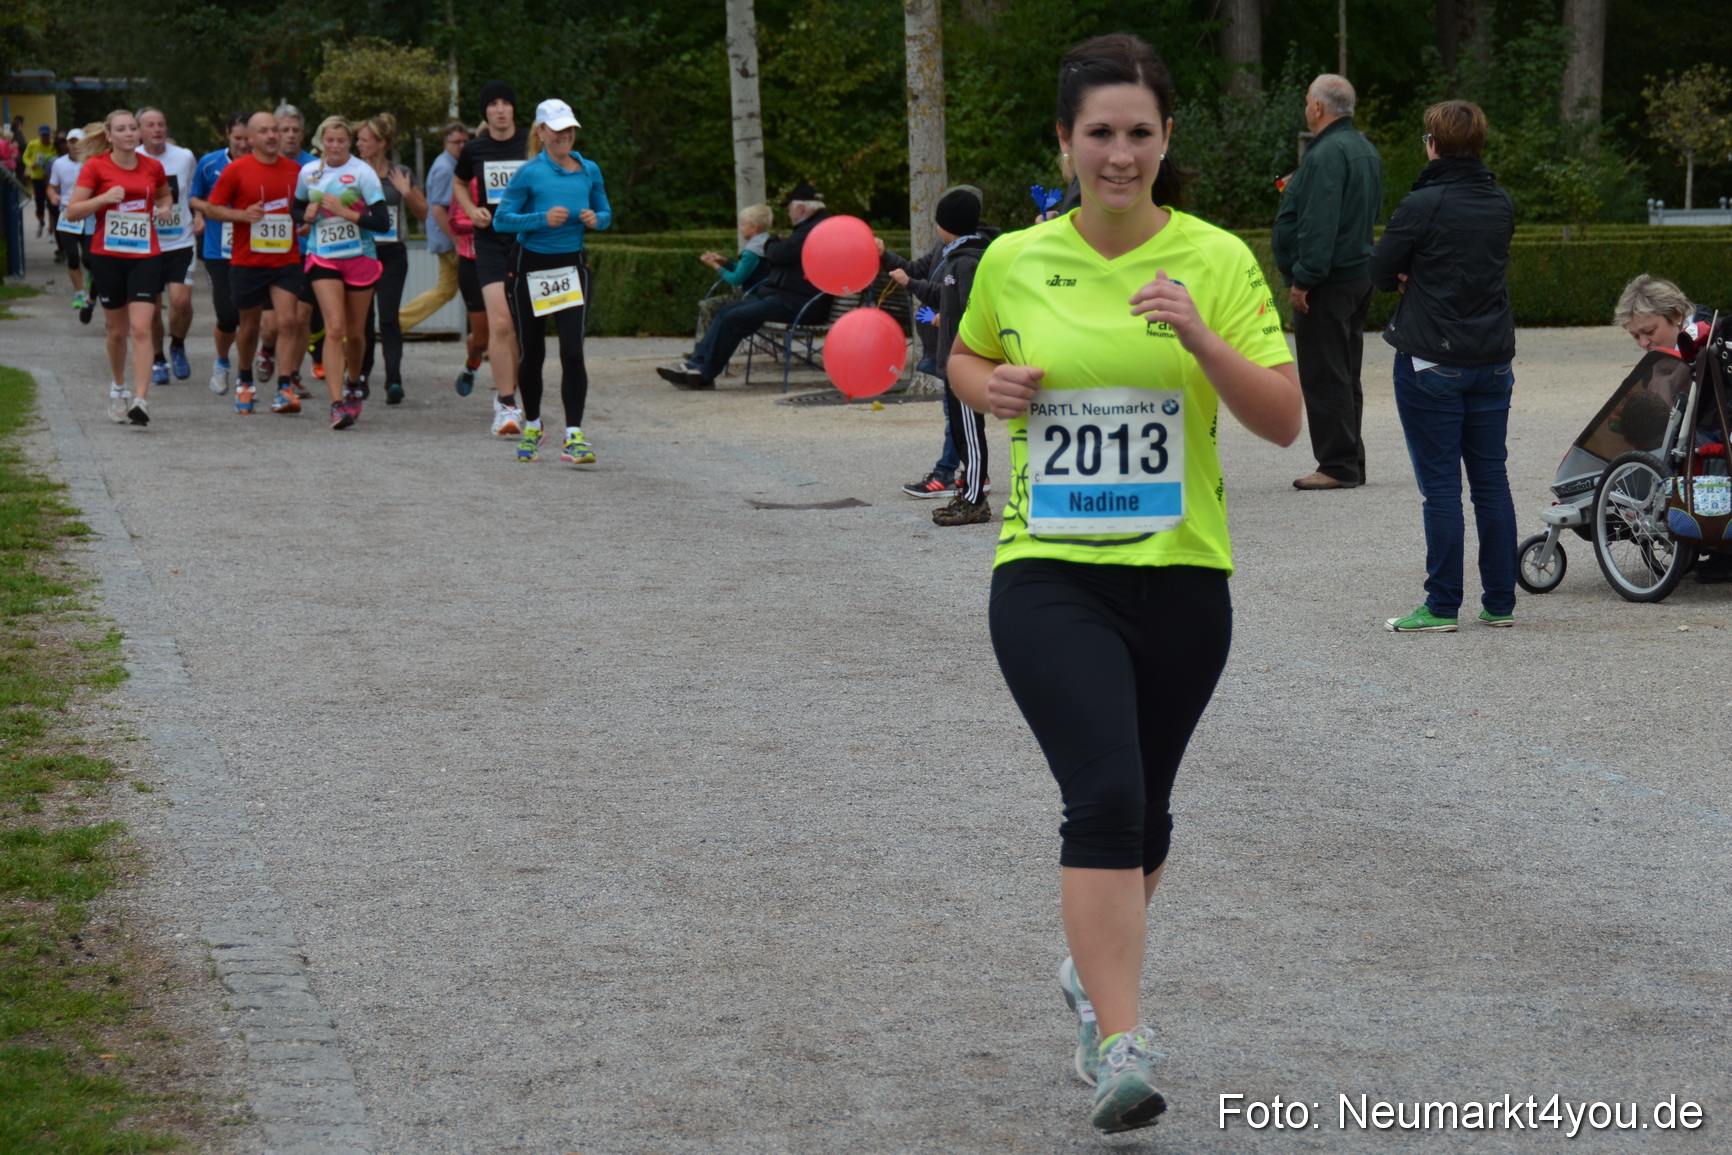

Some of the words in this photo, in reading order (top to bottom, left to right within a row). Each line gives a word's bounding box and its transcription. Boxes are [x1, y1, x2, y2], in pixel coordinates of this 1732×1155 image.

[490, 171, 515, 187] 30
[110, 220, 147, 238] 2546
[260, 223, 286, 238] 318
[320, 224, 356, 244] 2528
[540, 277, 570, 297] 348
[1030, 402, 1078, 416] PARTL
[1082, 401, 1155, 416] Neumarkt
[1044, 422, 1169, 476] 2013
[1069, 491, 1140, 512] Nadine
